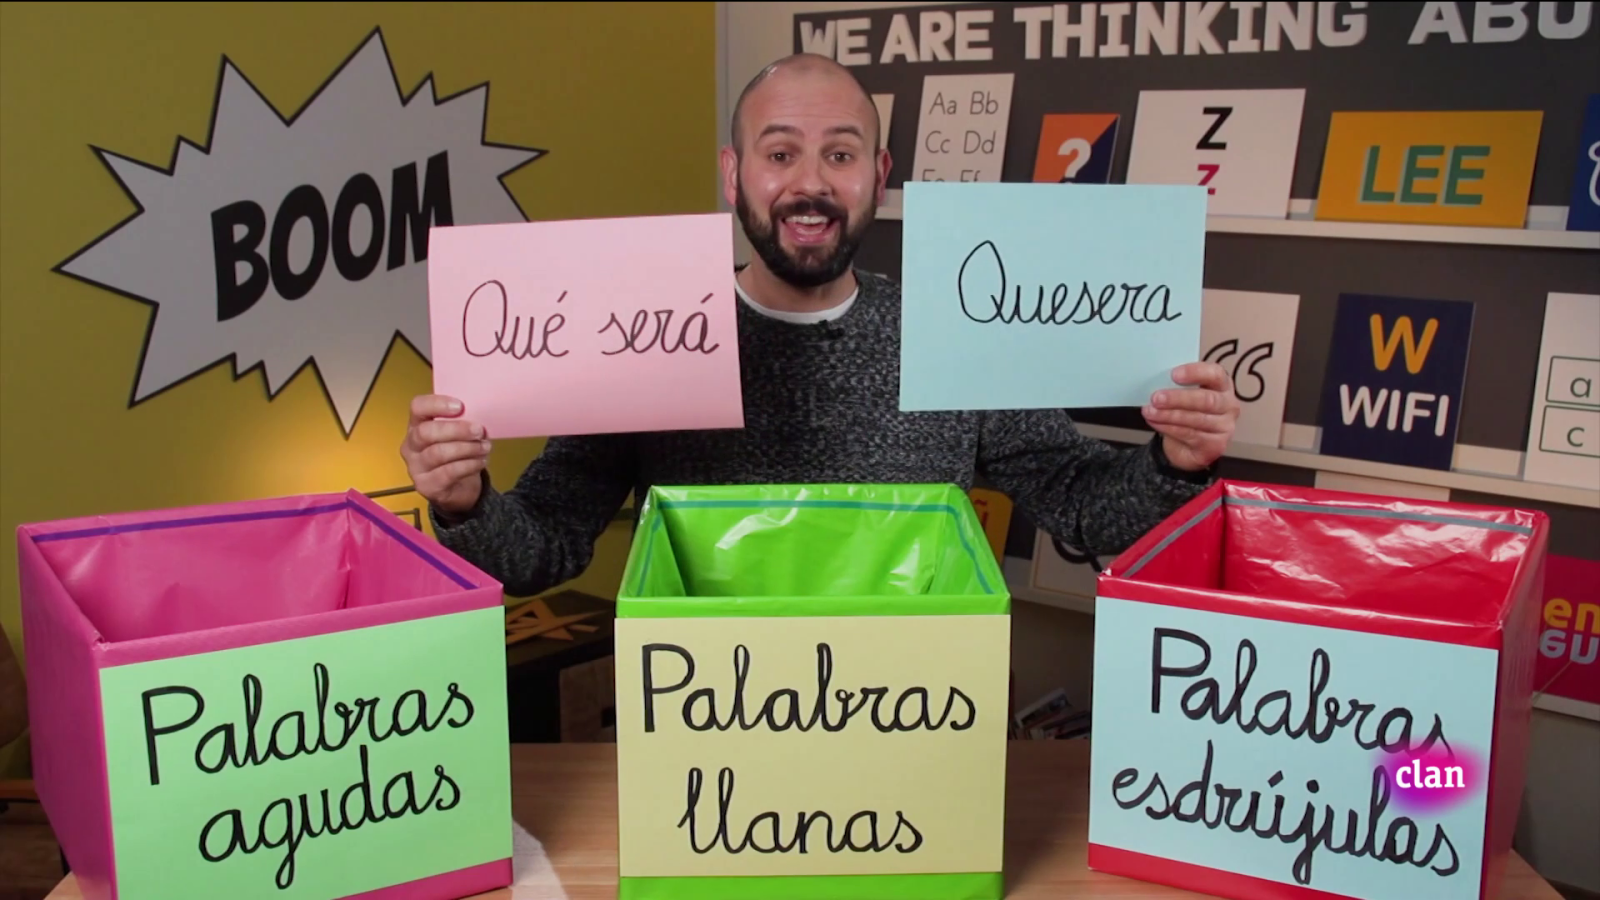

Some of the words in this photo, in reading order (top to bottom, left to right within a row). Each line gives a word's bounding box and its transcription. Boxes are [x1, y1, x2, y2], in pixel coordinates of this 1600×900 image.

[800, 17, 872, 67] WE
[880, 10, 994, 63] ARE
[1013, 2, 1367, 60] THINKING
[925, 130, 951, 154] Cc
[963, 130, 996, 154] Dd
[928, 91, 957, 116] Aa
[970, 90, 999, 115] Bb
[1195, 106, 1234, 150] Z
[1358, 144, 1491, 207] LEE
[210, 150, 455, 322] BOOM
[462, 279, 569, 360] Qué
[597, 292, 720, 355] será
[958, 239, 1182, 325] Quesera
[1369, 313, 1439, 375] W
[1339, 383, 1450, 437] WIFI
[141, 662, 475, 785] Palabras
[641, 642, 976, 733] Palabras
[1151, 627, 1456, 758] Palabras
[198, 744, 461, 890] agudas
[677, 767, 924, 854] llanas
[1111, 739, 1461, 885] esdrújulas
